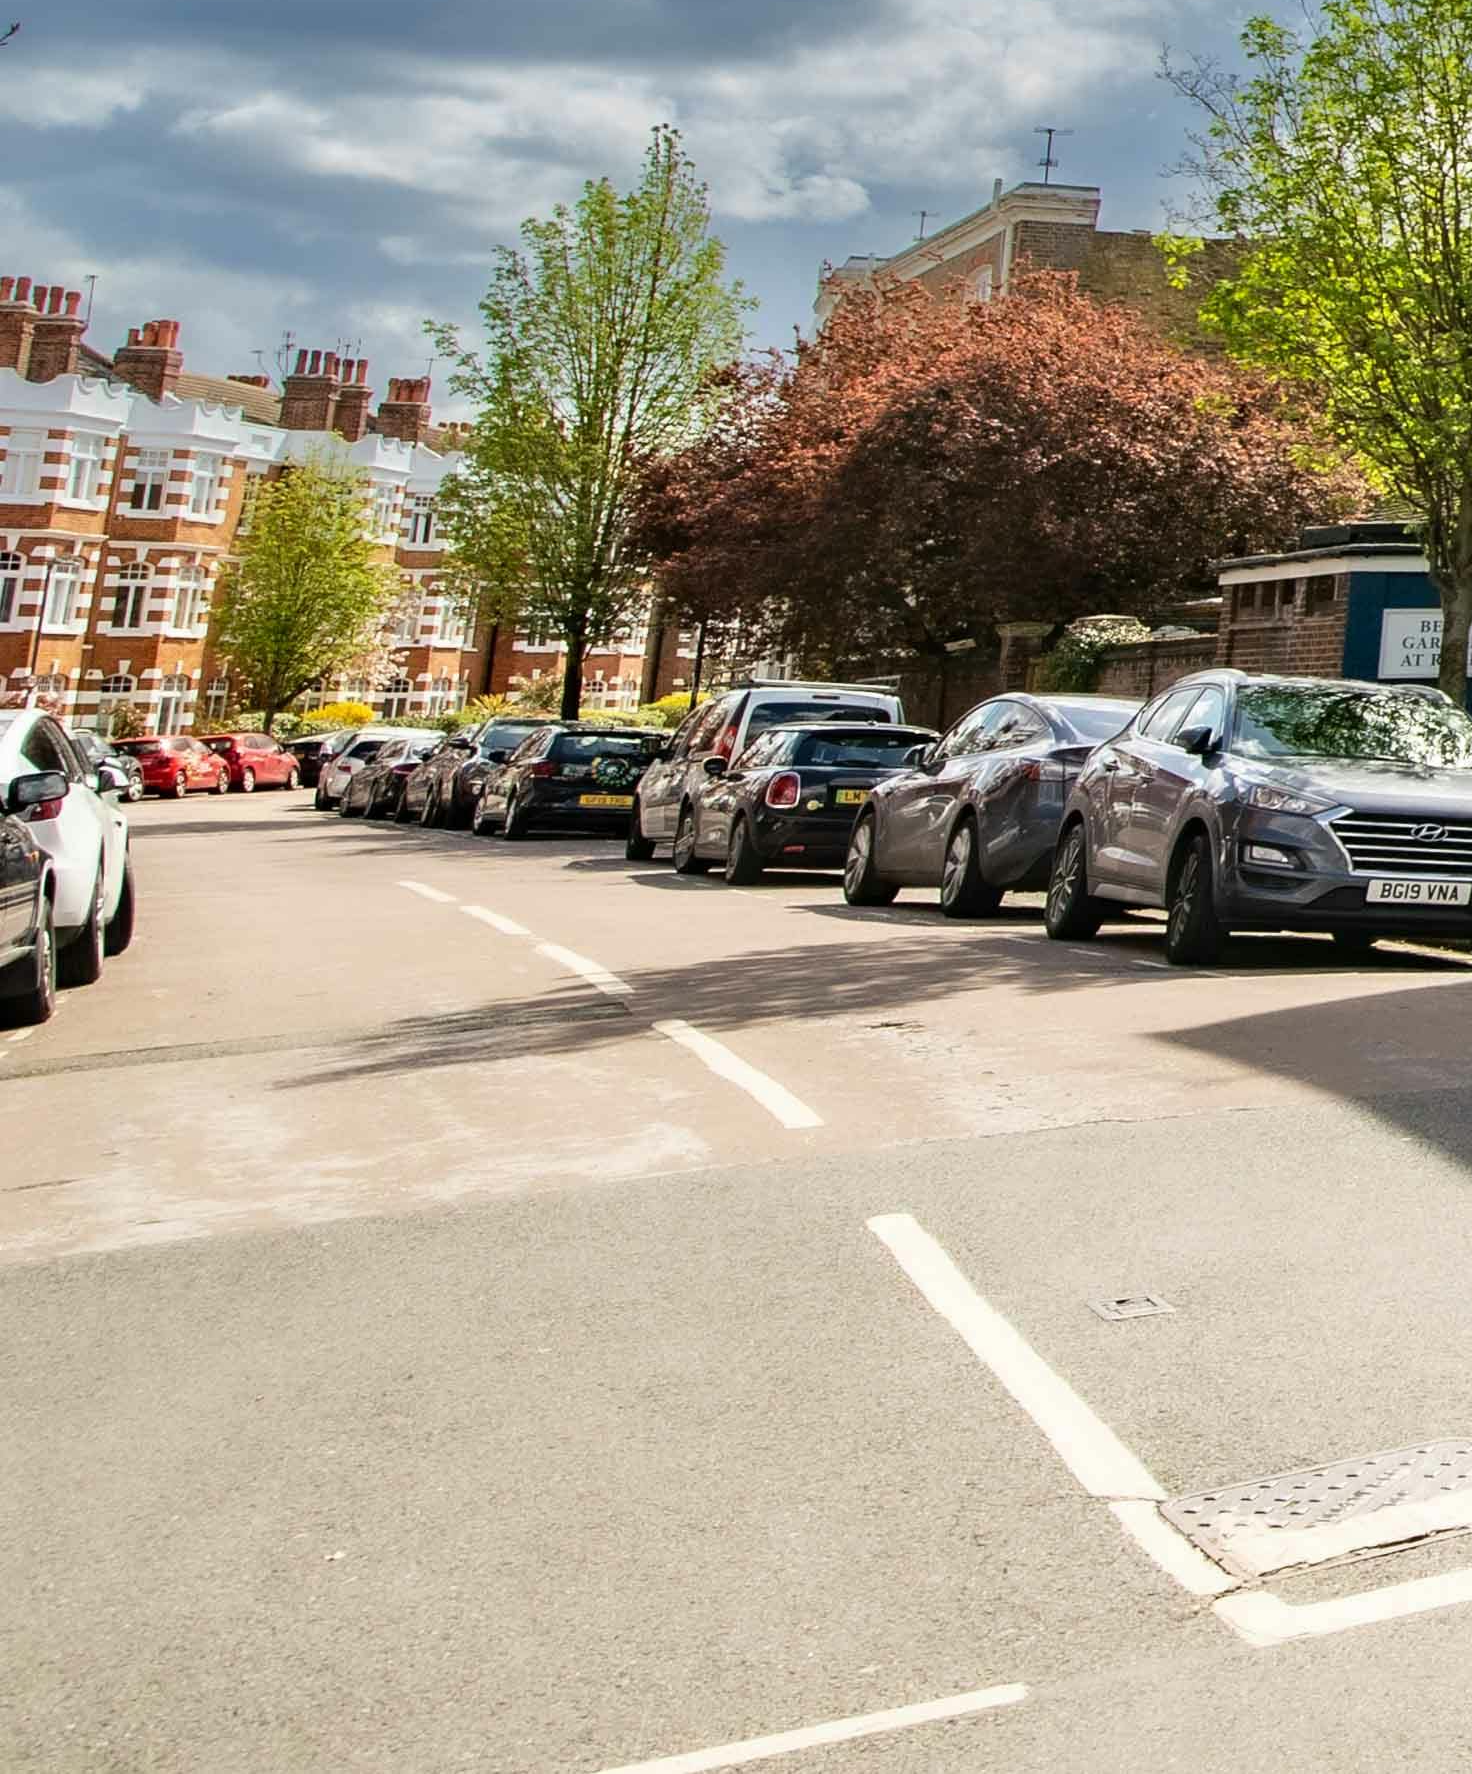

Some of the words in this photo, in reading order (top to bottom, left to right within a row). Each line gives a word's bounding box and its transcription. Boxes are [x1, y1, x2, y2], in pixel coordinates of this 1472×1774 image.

[1400, 653, 1424, 666] AT
[1380, 882, 1421, 899] BG19
[1427, 883, 1459, 901] VNA
